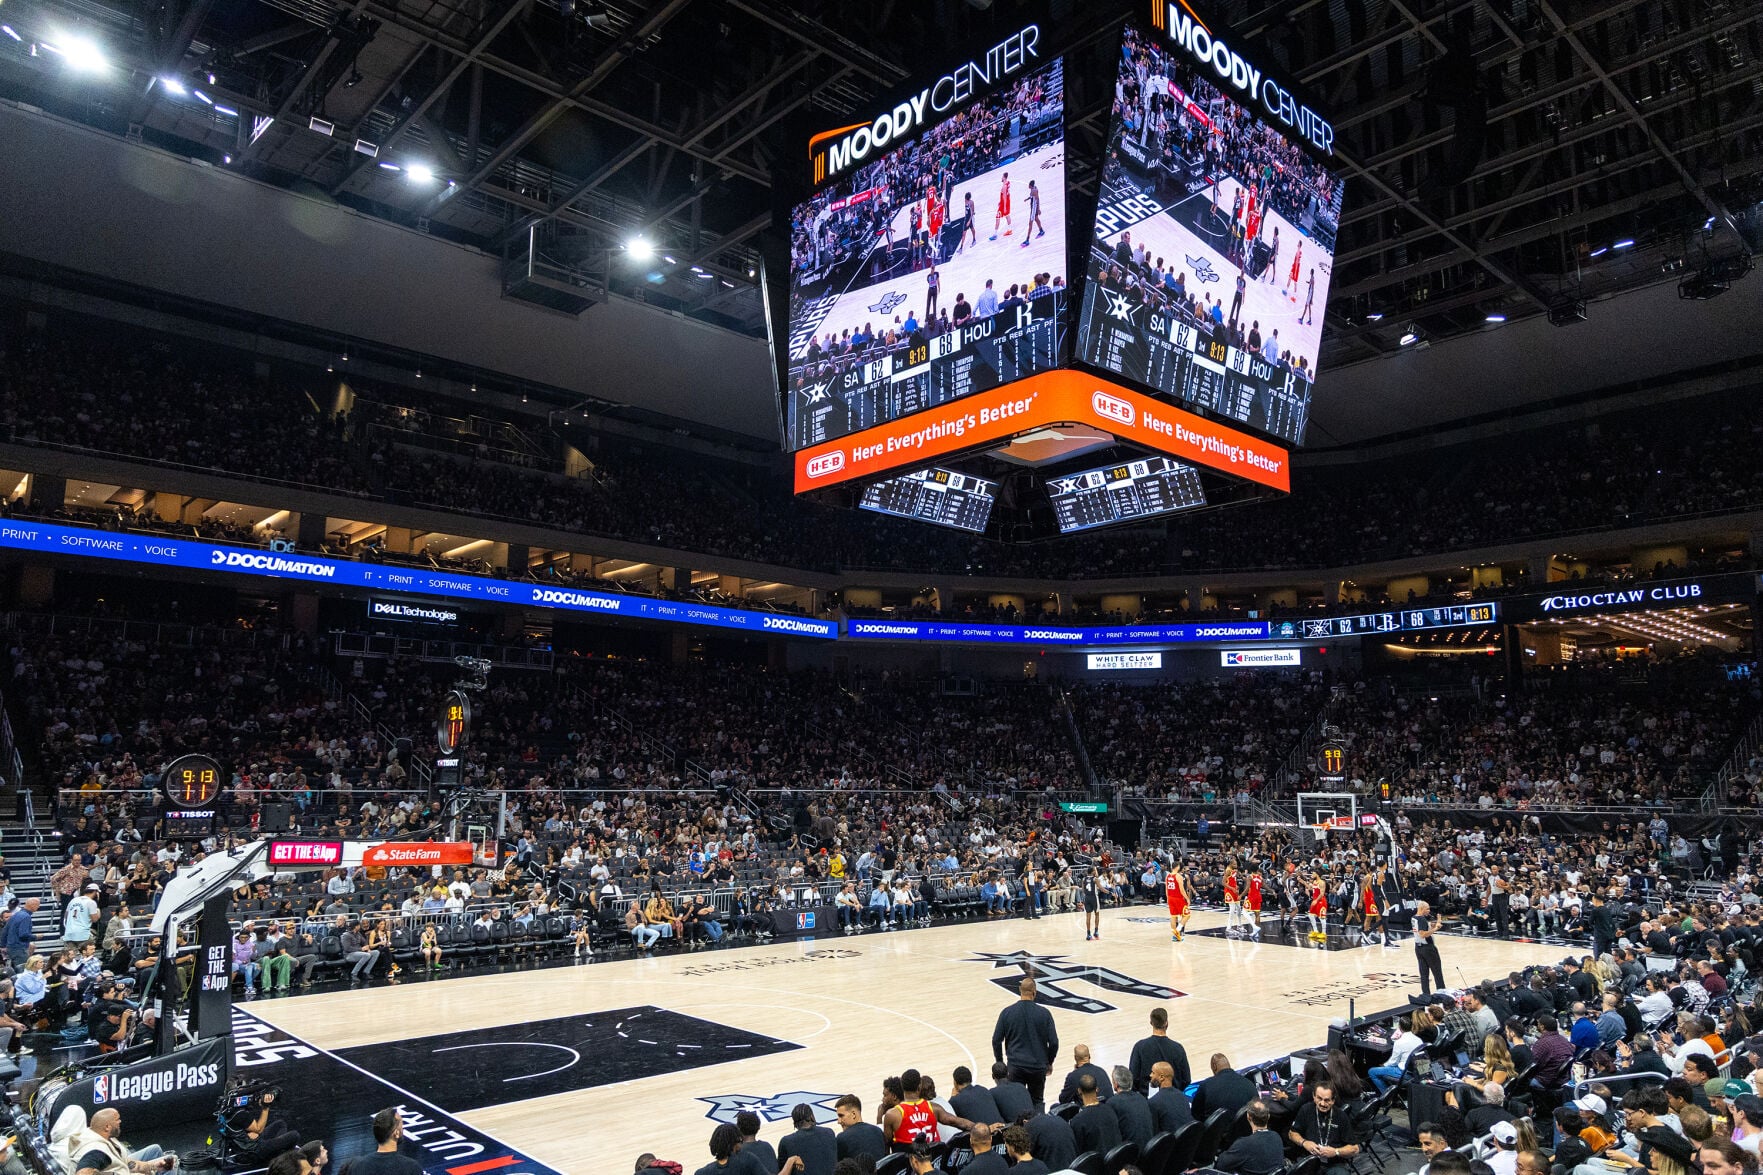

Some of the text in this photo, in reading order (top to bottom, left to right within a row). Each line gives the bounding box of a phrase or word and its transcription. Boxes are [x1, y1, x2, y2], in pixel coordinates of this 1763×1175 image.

[1169, 4, 1334, 156] MOODY CENTER
[829, 24, 1041, 176] MOODY CENTER
[844, 371, 859, 388] SA
[871, 362, 884, 381] 62
[909, 345, 926, 365] 9:13
[939, 333, 953, 356] 68
[964, 322, 992, 345] HOU
[1150, 314, 1165, 335] SA
[1177, 323, 1189, 346] 62
[1251, 360, 1272, 381] HOU
[852, 446, 883, 463] Here
[887, 413, 976, 452] Everything's
[980, 395, 1033, 424] Better
[1143, 411, 1173, 436] Here
[1176, 423, 1244, 463] Everything's
[1247, 449, 1279, 474] Better
[1134, 463, 1145, 476] 68
[2, 528, 177, 557] PRINT SOFTWARE VOICE
[226, 552, 335, 577] DOCUMATION
[364, 571, 509, 596] IT PRINT SOFTWARE VOICE
[543, 589, 621, 610] DOCUMATION
[1550, 584, 1702, 609] CHOCTAW CLUB
[374, 603, 457, 621] DELL Technologies
[641, 604, 746, 624] IT PRINT SOFTWARE VOICE
[1340, 619, 1352, 633] 62
[1411, 612, 1424, 627] 68
[1453, 611, 1463, 621] 3rd
[1470, 607, 1489, 621] 9:13
[771, 618, 829, 634] DOCUMATION
[863, 624, 918, 634] DOCUMATION
[1030, 630, 1083, 640] DOCUMATION
[1204, 628, 1262, 636] DOCUMATION
[1244, 653, 1294, 662] Frontier Bank
[183, 770, 214, 784] 9:13
[186, 784, 206, 801] 11
[180, 810, 215, 818] TISSOT
[274, 845, 337, 861] GET THE App
[389, 849, 440, 860] State Farm
[208, 945, 226, 960] GET
[208, 960, 225, 974] THE
[210, 975, 229, 992] App
[111, 1063, 218, 1101] League Pass
